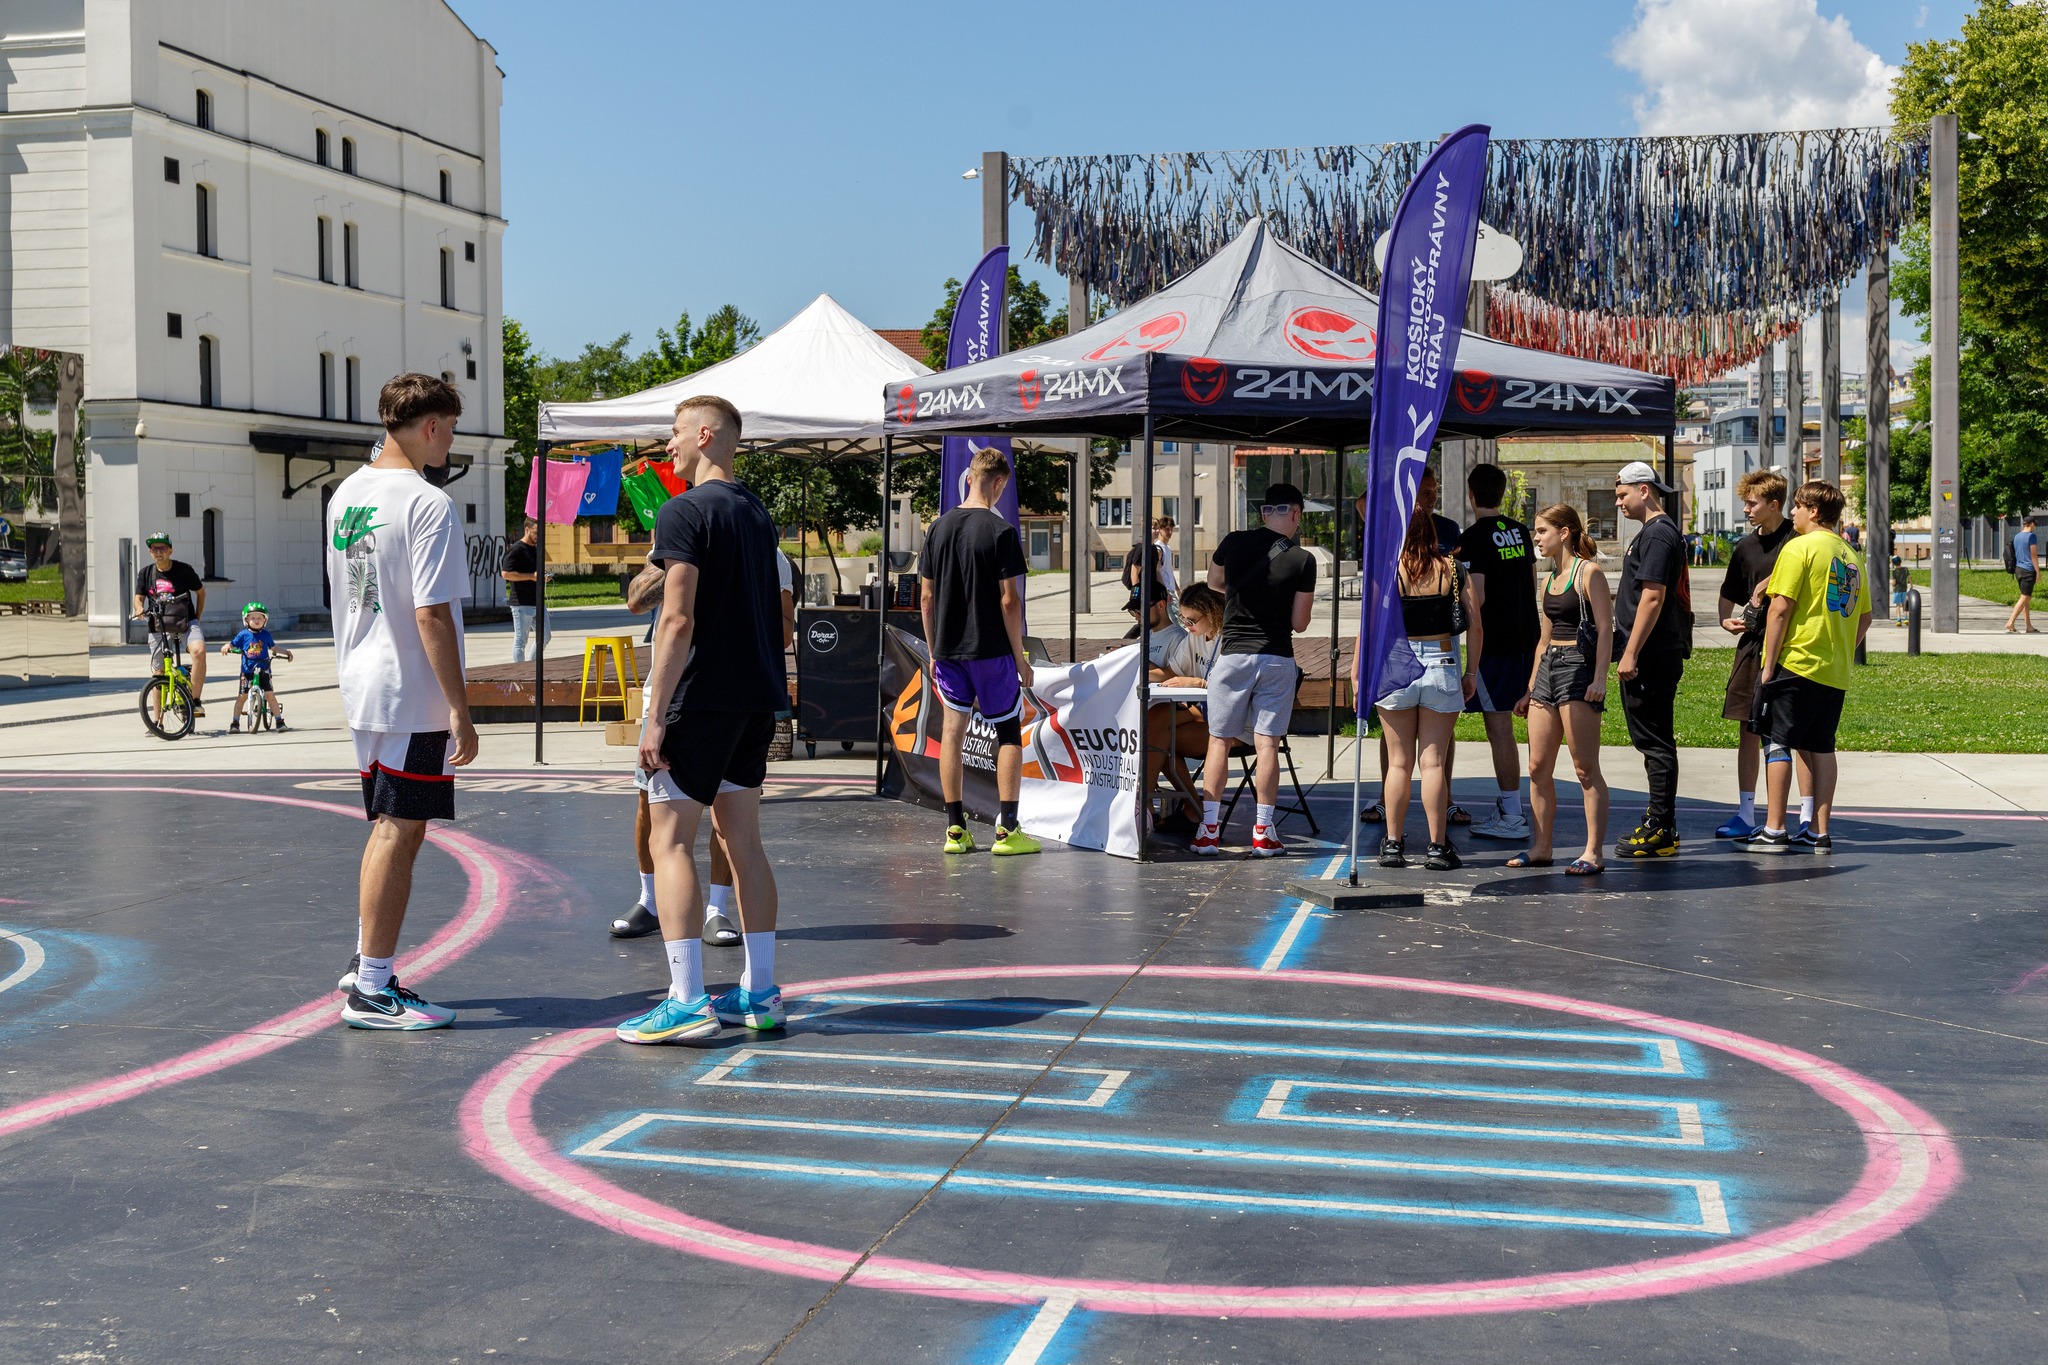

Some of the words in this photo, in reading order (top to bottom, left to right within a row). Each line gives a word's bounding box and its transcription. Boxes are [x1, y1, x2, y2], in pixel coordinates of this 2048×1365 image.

[977, 279, 990, 360] PRÁVNY
[1405, 255, 1428, 382] KOŠICKÝ
[1425, 313, 1446, 389] KRAJ
[1043, 365, 1126, 402] 24MX
[1233, 368, 1375, 401] 24MX
[1502, 380, 1642, 415] 24MX
[917, 382, 986, 418] 24MX
[1492, 528, 1524, 547] ONE
[1497, 544, 1526, 560] TEAM
[966, 711, 998, 739] COS
[962, 735, 993, 757] USTRIAL
[1069, 728, 1138, 755] EUCOS
[961, 752, 997, 772] TRUCTIONS
[1079, 753, 1137, 775] INDUSTRIAL
